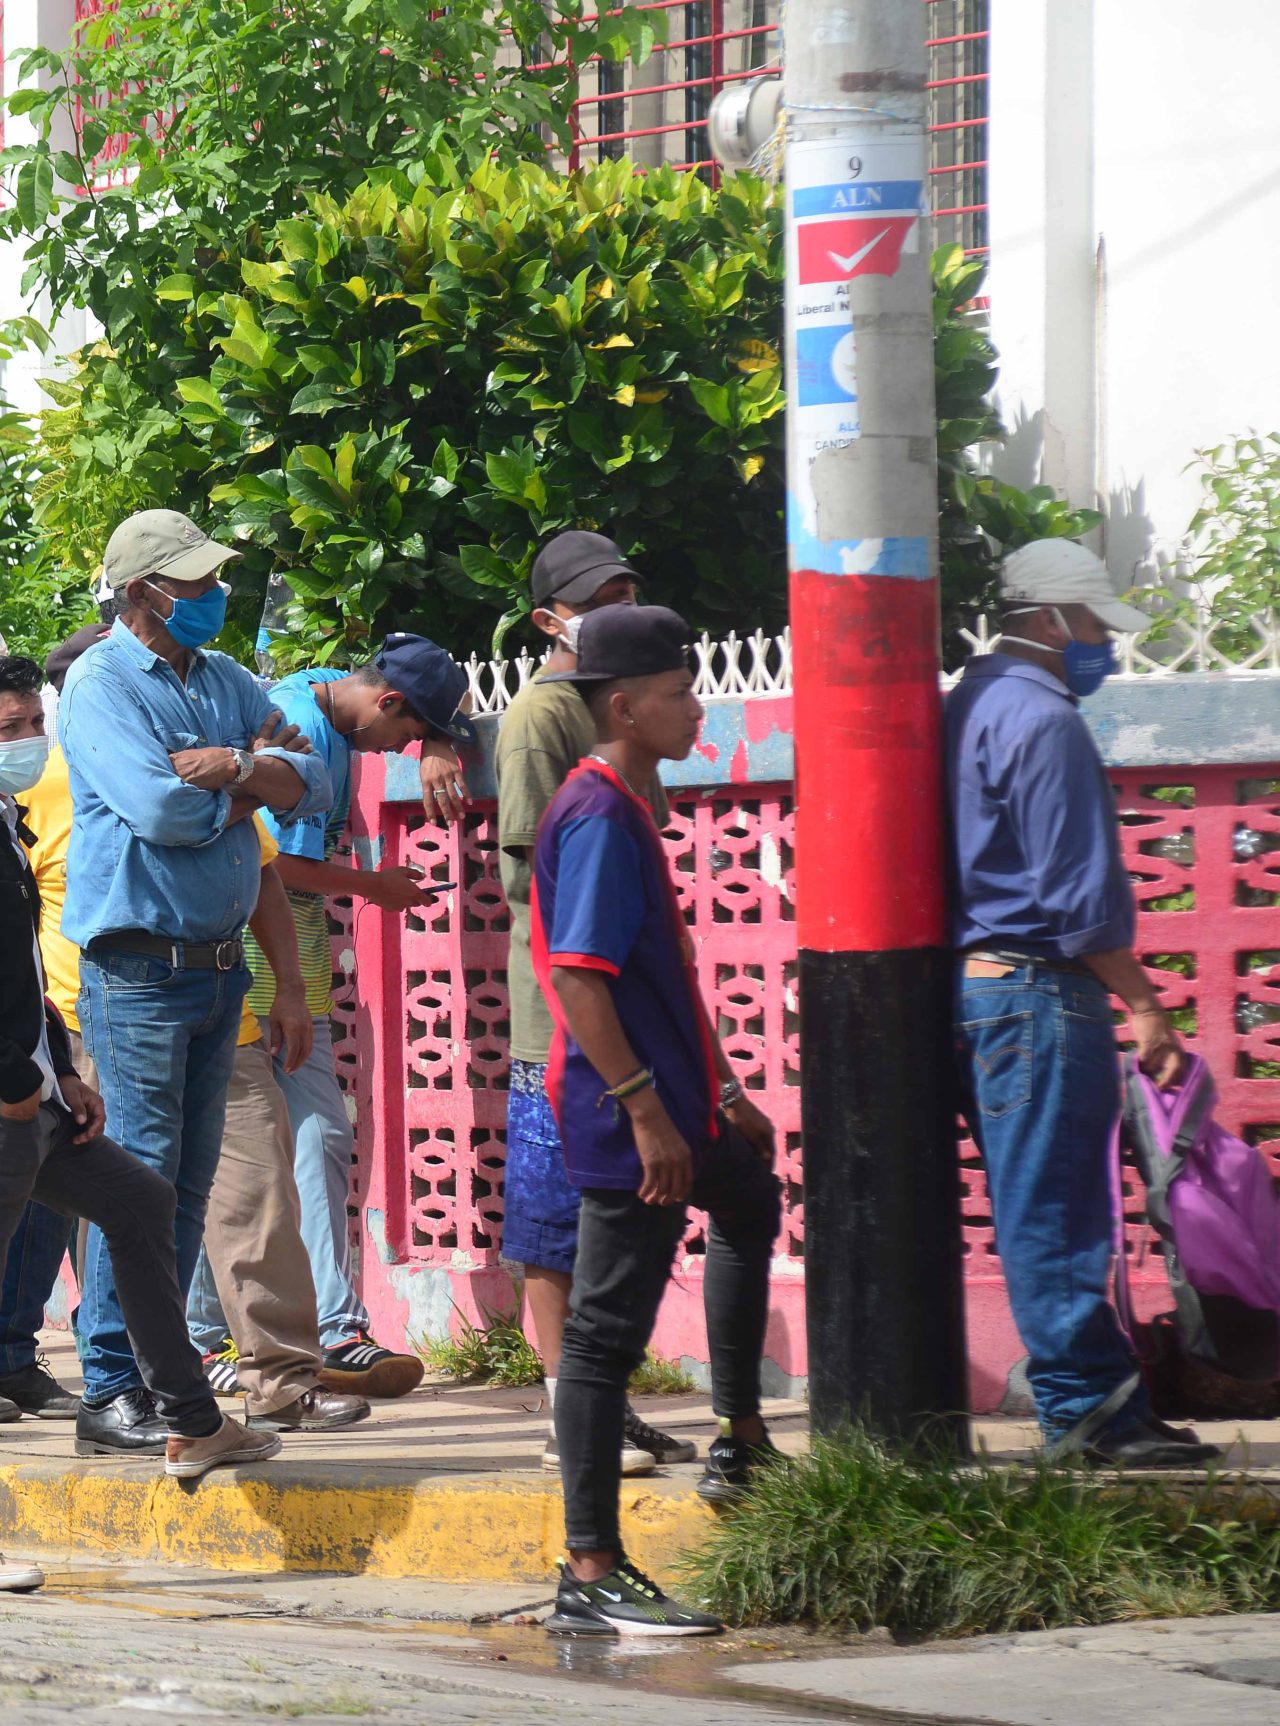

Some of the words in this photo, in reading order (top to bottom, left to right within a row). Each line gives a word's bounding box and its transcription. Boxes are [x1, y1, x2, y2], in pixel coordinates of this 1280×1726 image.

[848, 156, 863, 180] 9
[831, 186, 883, 208] ALN
[797, 302, 835, 316] Liberal
